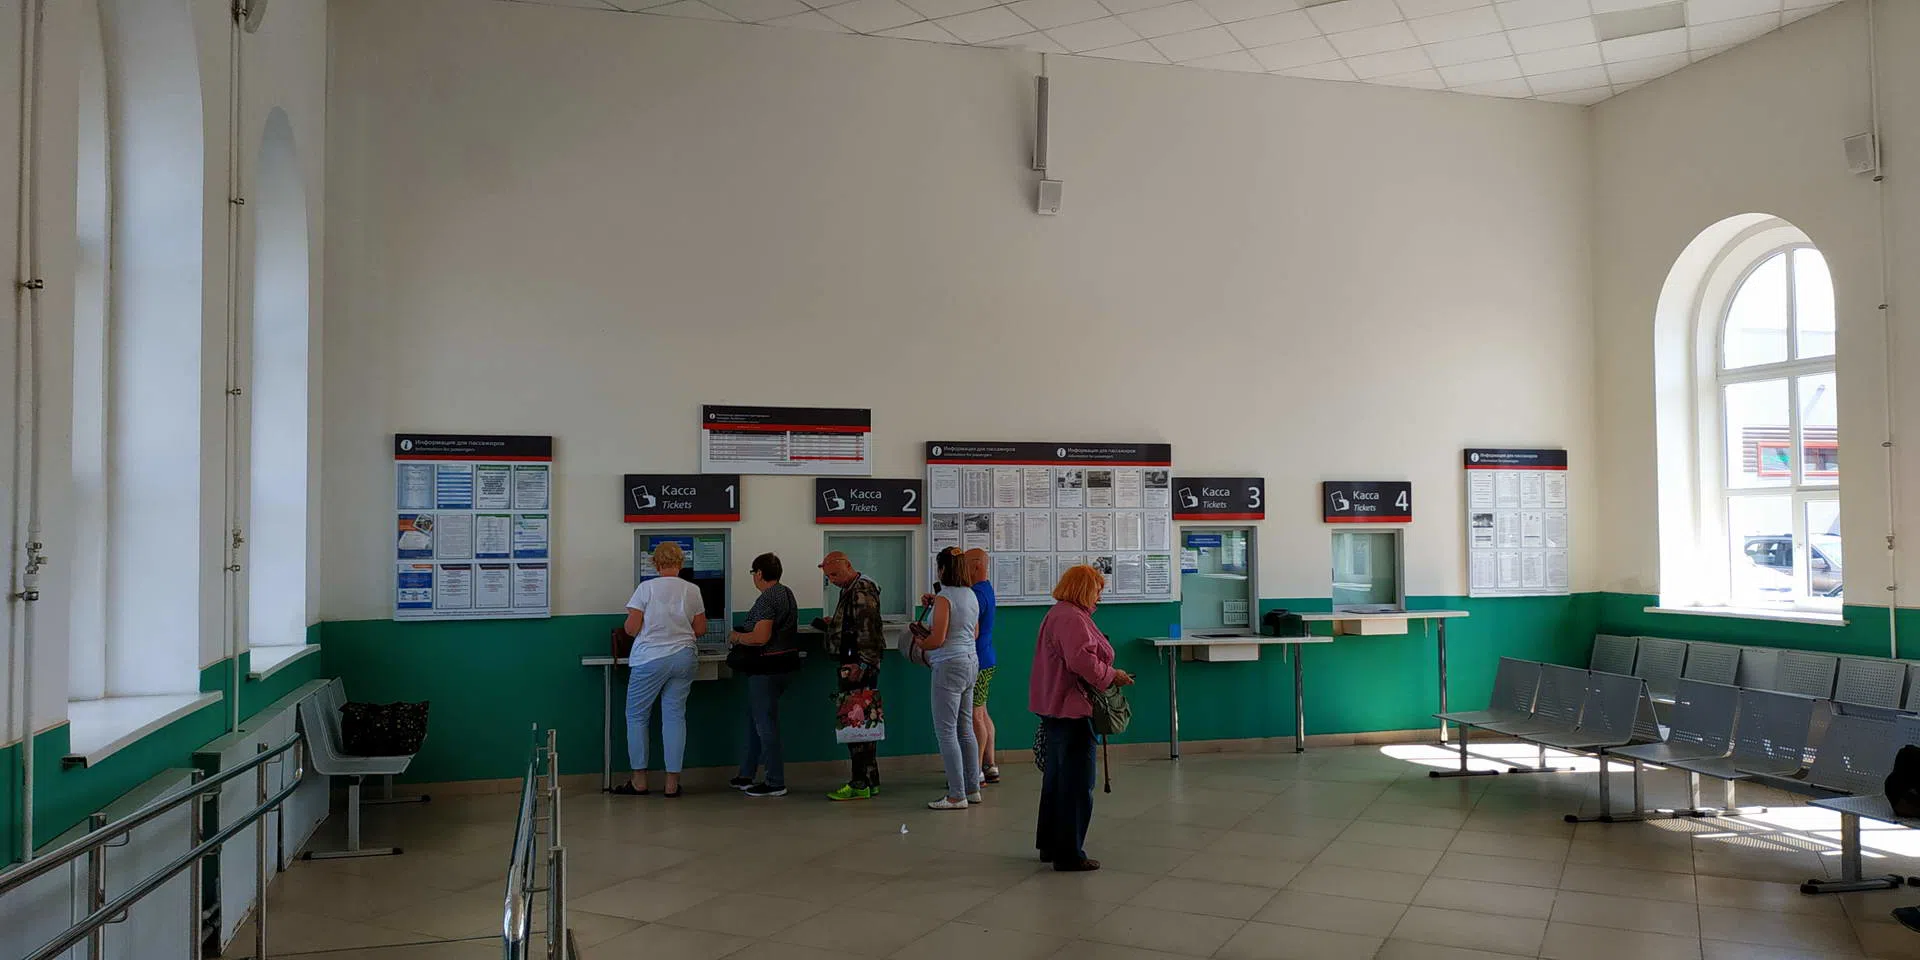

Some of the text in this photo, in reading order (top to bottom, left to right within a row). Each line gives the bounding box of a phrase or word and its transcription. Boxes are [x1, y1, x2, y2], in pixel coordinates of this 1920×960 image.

[661, 485, 735, 509] Касса 1
[662, 500, 692, 509] Tickets
[850, 488, 917, 512] Касса 2
[1202, 487, 1261, 509] Касса 3
[1353, 490, 1409, 512] Касса 4
[850, 503, 878, 512] Tickets
[1203, 501, 1228, 509] Tickets
[1354, 504, 1377, 512] Tickets
